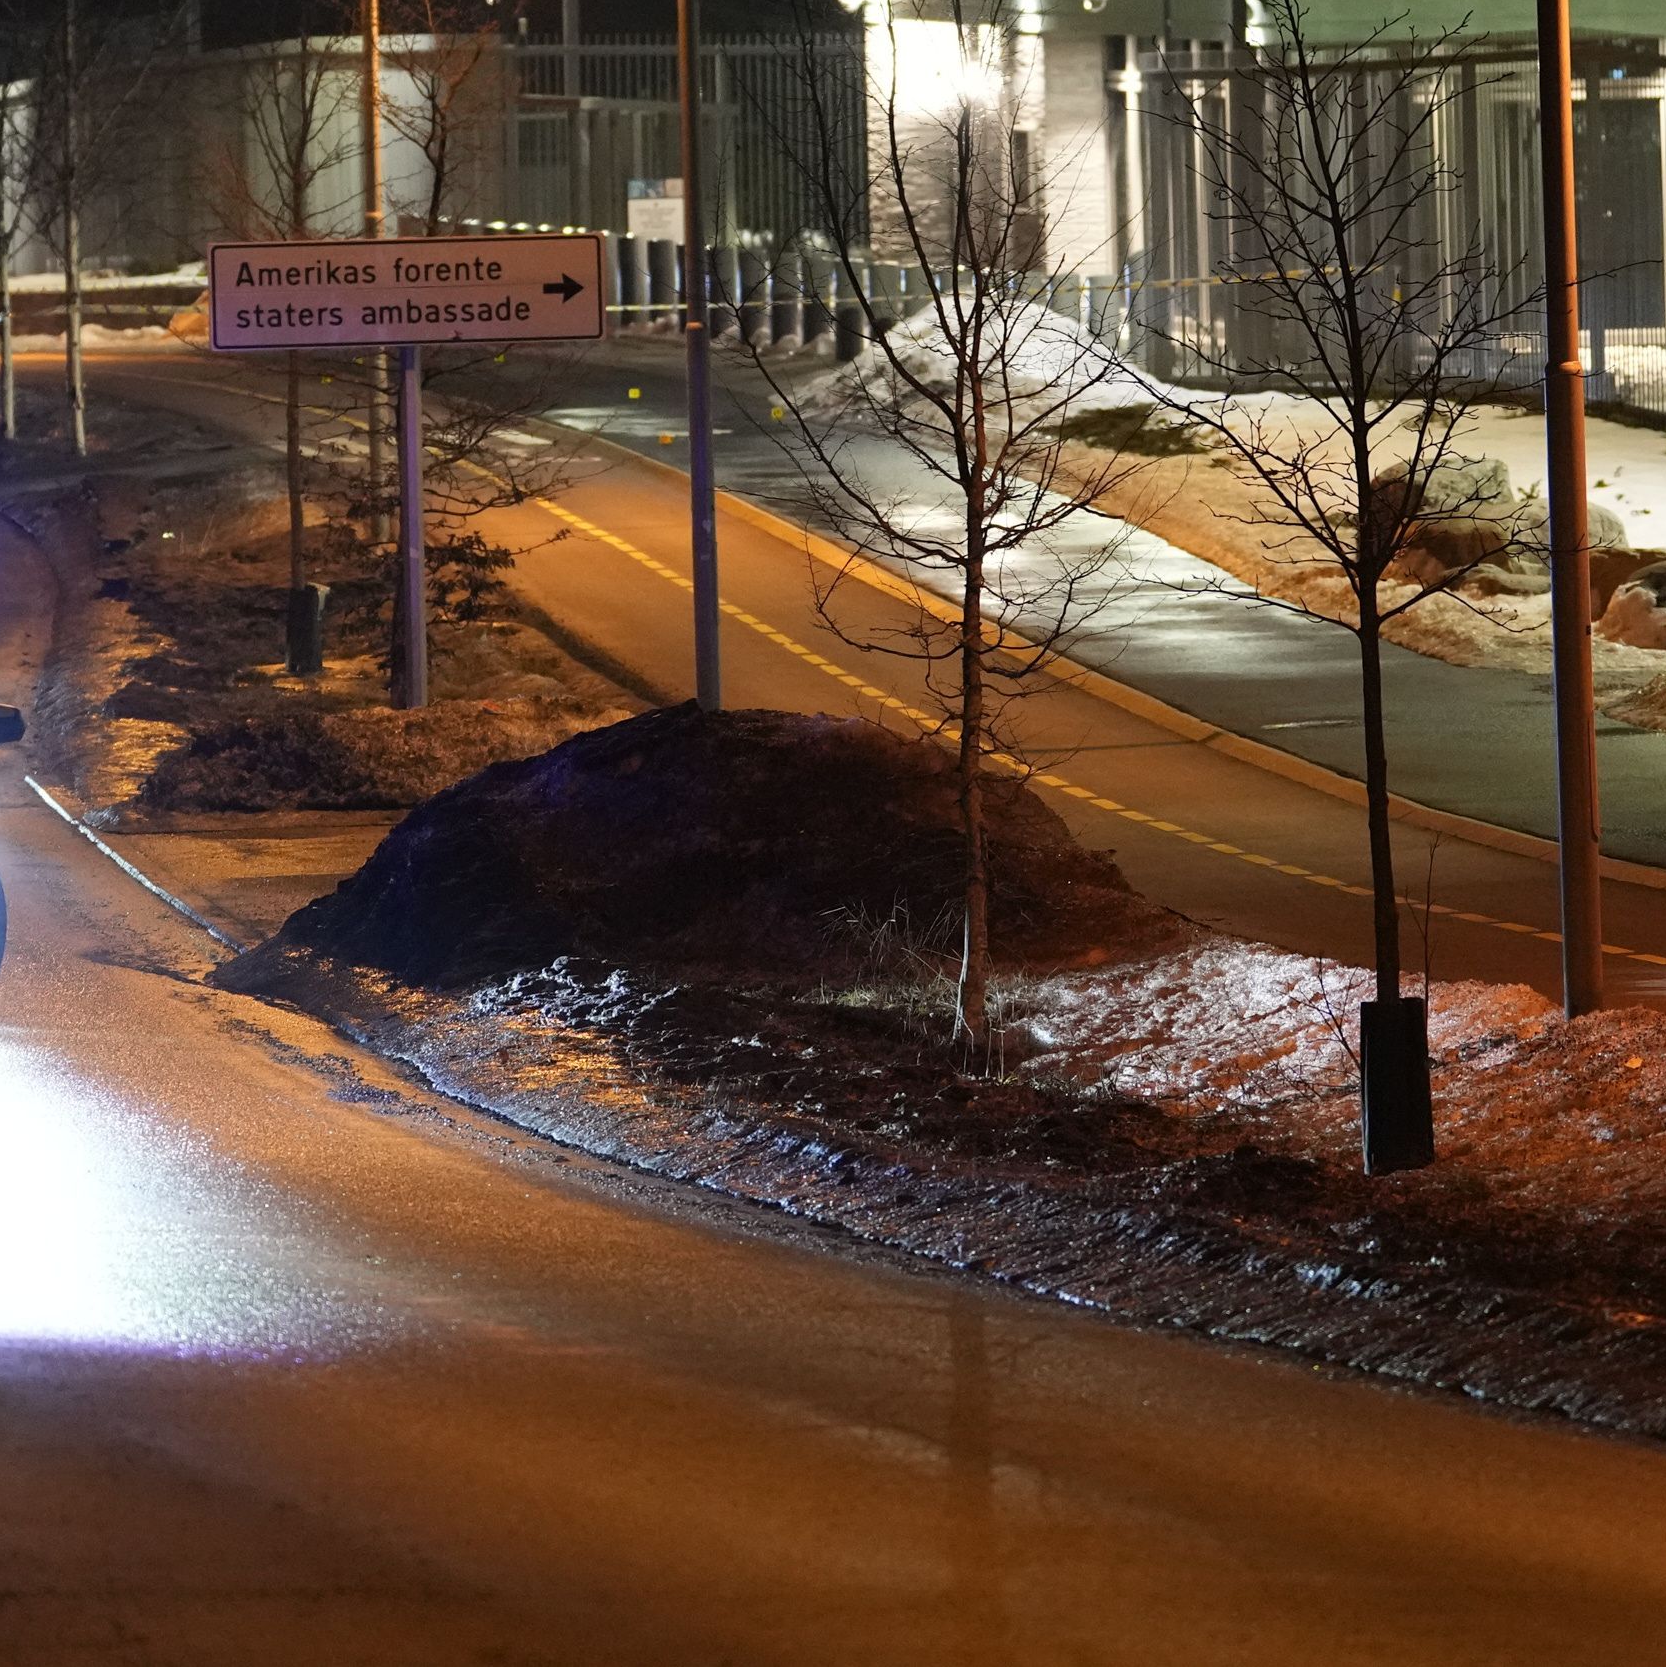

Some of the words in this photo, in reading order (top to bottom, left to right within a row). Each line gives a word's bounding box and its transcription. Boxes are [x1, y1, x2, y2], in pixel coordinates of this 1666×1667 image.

[235, 259, 377, 286] Amerikas
[393, 257, 502, 283] forente
[236, 302, 343, 328] staters
[361, 296, 531, 325] ambassade
